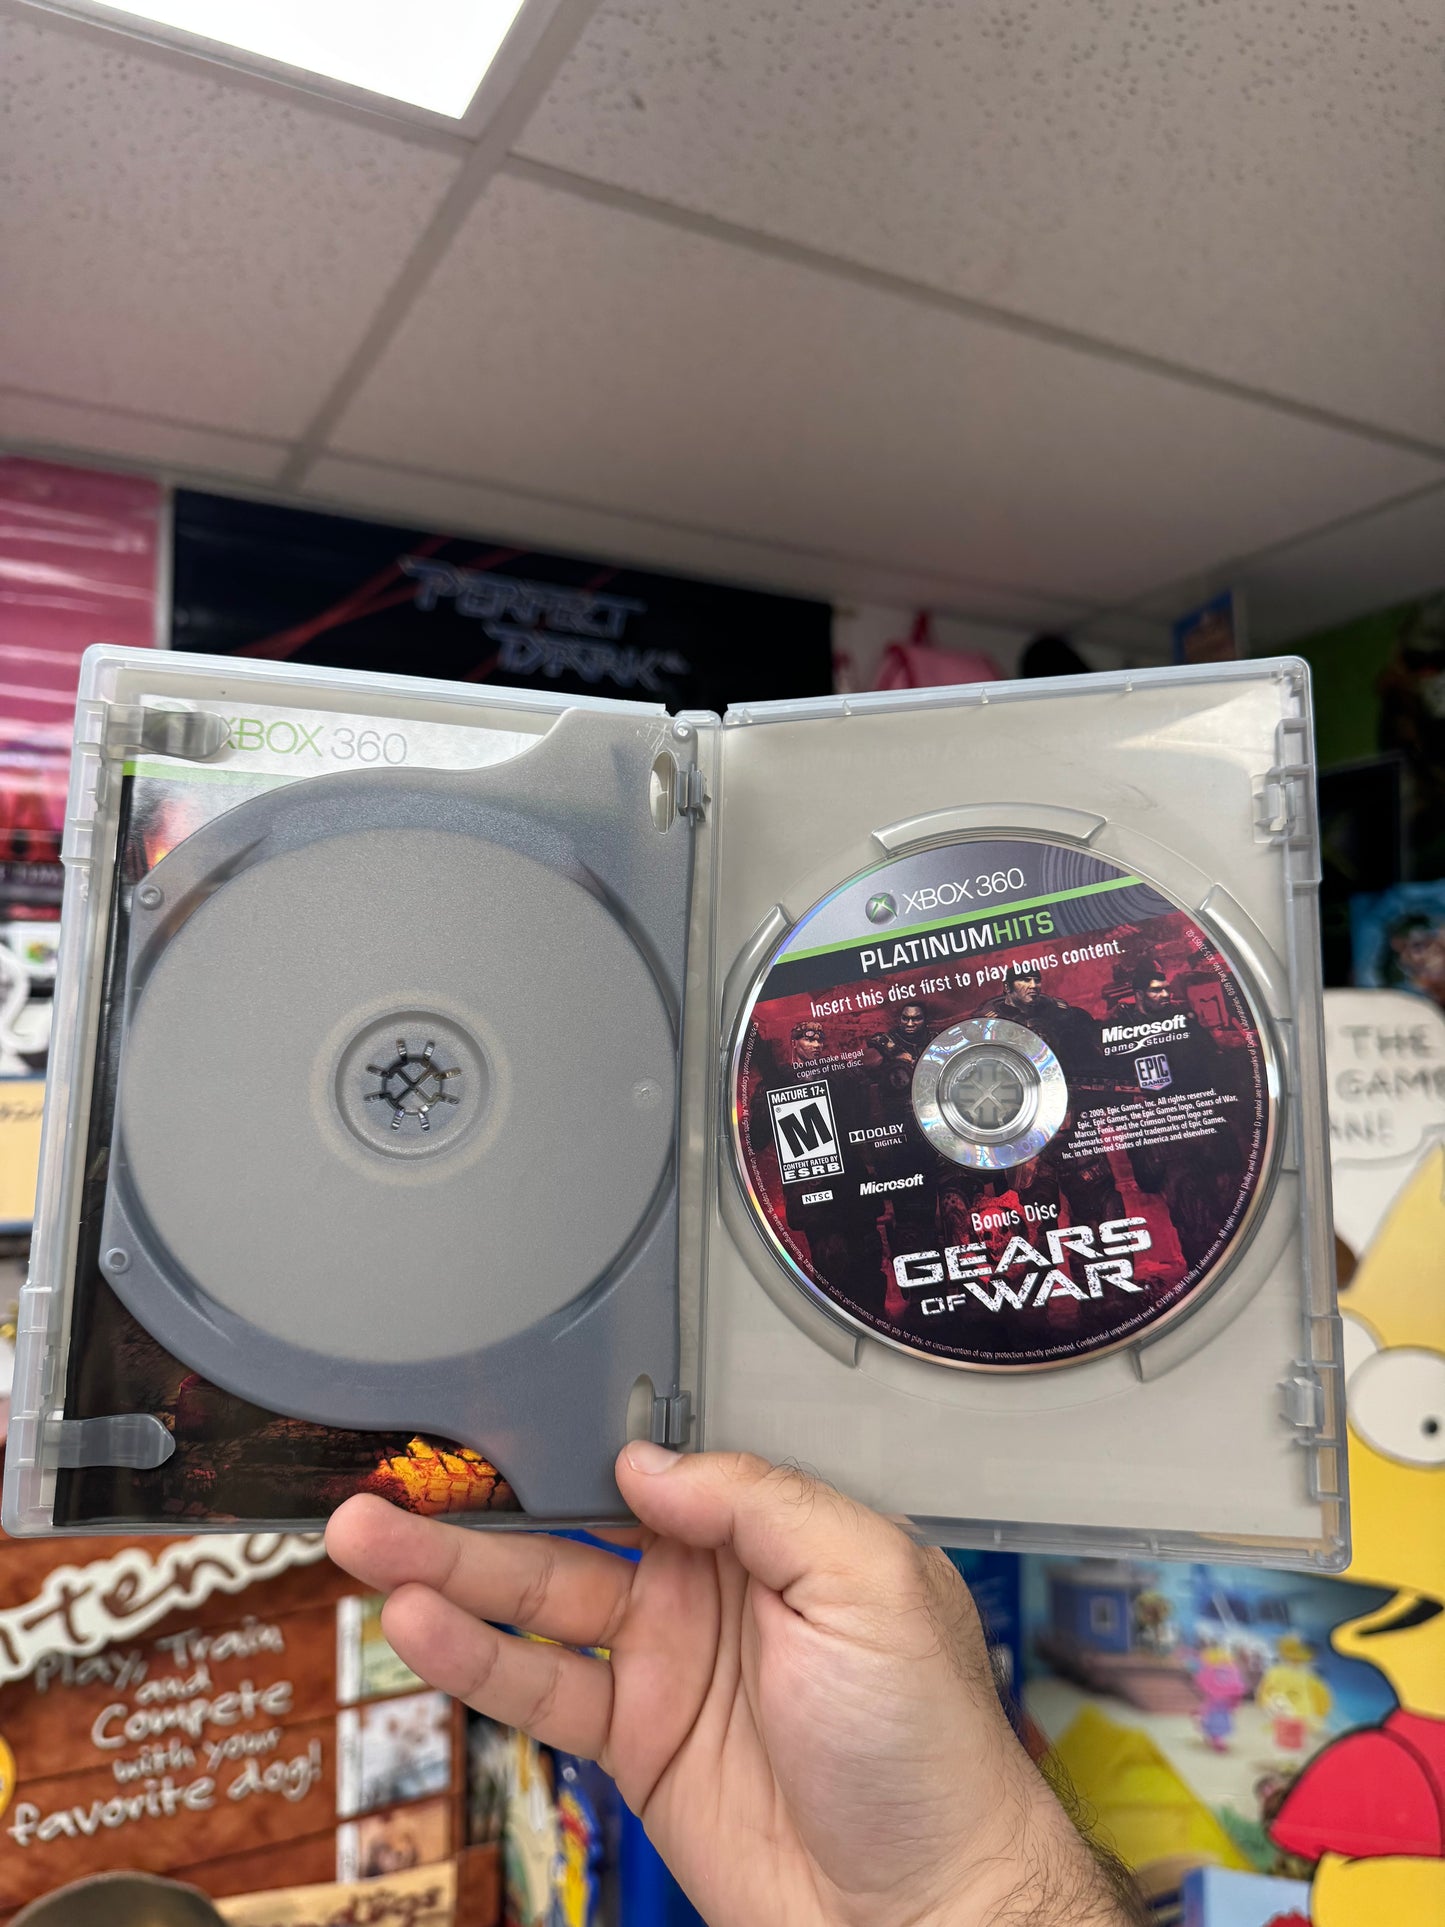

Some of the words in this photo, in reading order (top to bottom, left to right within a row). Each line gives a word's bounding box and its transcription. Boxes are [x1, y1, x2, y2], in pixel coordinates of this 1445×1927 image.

[331, 728, 407, 764] 360
[903, 879, 974, 914] XBOX
[976, 868, 1024, 899] 360
[809, 993, 852, 1017] Insert
[853, 987, 884, 1008] this
[887, 981, 916, 1002] disc
[918, 974, 952, 995] first
[954, 971, 972, 987] to
[975, 961, 1010, 986] play
[1011, 951, 1058, 975] bonus
[1060, 937, 1125, 964] content.
[1102, 1014, 1186, 1043] Microsoft
[1339, 1024, 1432, 1060] THE
[792, 1061, 804, 1070] Do
[805, 1060, 818, 1068] not
[819, 1056, 840, 1065] make
[840, 1049, 865, 1062] illegal
[796, 1068, 821, 1079] copies
[822, 1064, 831, 1073] of
[831, 1061, 846, 1071] this
[846, 1059, 864, 1069] disc.
[1137, 1055, 1169, 1081] EPIC
[771, 1088, 808, 1104] MATURE
[810, 1086, 826, 1097] 17+
[1141, 1077, 1170, 1087] GAMES
[1092, 1117, 1106, 1127] Epic
[1130, 1110, 1140, 1119] the
[1142, 1108, 1155, 1118] Epic
[1155, 1104, 1177, 1114] Games
[1195, 1097, 1214, 1107] Gears
[1214, 1095, 1221, 1104] of
[1107, 1105, 1120, 1115] Epic
[1144, 1098, 1156, 1107] Inc.
[1157, 1096, 1166, 1105] All
[1167, 1093, 1186, 1105] rights
[1186, 1087, 1216, 1100] reserved.
[778, 1102, 833, 1158] M
[866, 1124, 904, 1139] DOLBY
[1067, 1136, 1103, 1149] trademarks
[1112, 1129, 1143, 1143] registered
[1144, 1122, 1179, 1136] trademarks
[1180, 1120, 1188, 1129] of
[1188, 1118, 1202, 1129] Epic
[1074, 1128, 1096, 1138] Marcus
[1097, 1125, 1114, 1134] Fenix
[1114, 1122, 1127, 1131] and
[1127, 1120, 1138, 1129] the
[1139, 1115, 1165, 1127] Crimson
[1166, 1112, 1185, 1122] Omen
[1186, 1109, 1201, 1121] logo
[874, 1138, 902, 1148] DIGITAL
[1062, 1150, 1073, 1159] Inc.
[1081, 1147, 1092, 1155] the
[1093, 1143, 1114, 1153] United
[1114, 1140, 1134, 1150] States
[1134, 1138, 1142, 1146] of
[1142, 1133, 1169, 1145] America
[1169, 1131, 1182, 1140] and
[1182, 1125, 1217, 1138] elsewhere.
[783, 1160, 809, 1171] CONTENT
[810, 1157, 829, 1167] RATED
[830, 1155, 839, 1163] BY
[784, 1162, 841, 1181] ESRB
[804, 1192, 832, 1203] NTSC
[859, 1173, 924, 1196] Microsoft
[771, 1212, 785, 1232] reverse
[971, 1209, 1020, 1231] Bonus
[1024, 1201, 1058, 1223] Disc
[893, 1217, 1152, 1288] GEARS
[920, 1293, 967, 1316] OF
[963, 1259, 1144, 1312] WAR
[156, 1616, 284, 1668] Train
[135, 1664, 212, 1704] and
[91, 1680, 293, 1749] Compete
[112, 1737, 196, 1784] with
[203, 1726, 282, 1770] your
[6, 1777, 216, 1846] favorite
[227, 1738, 322, 1801] dog!
